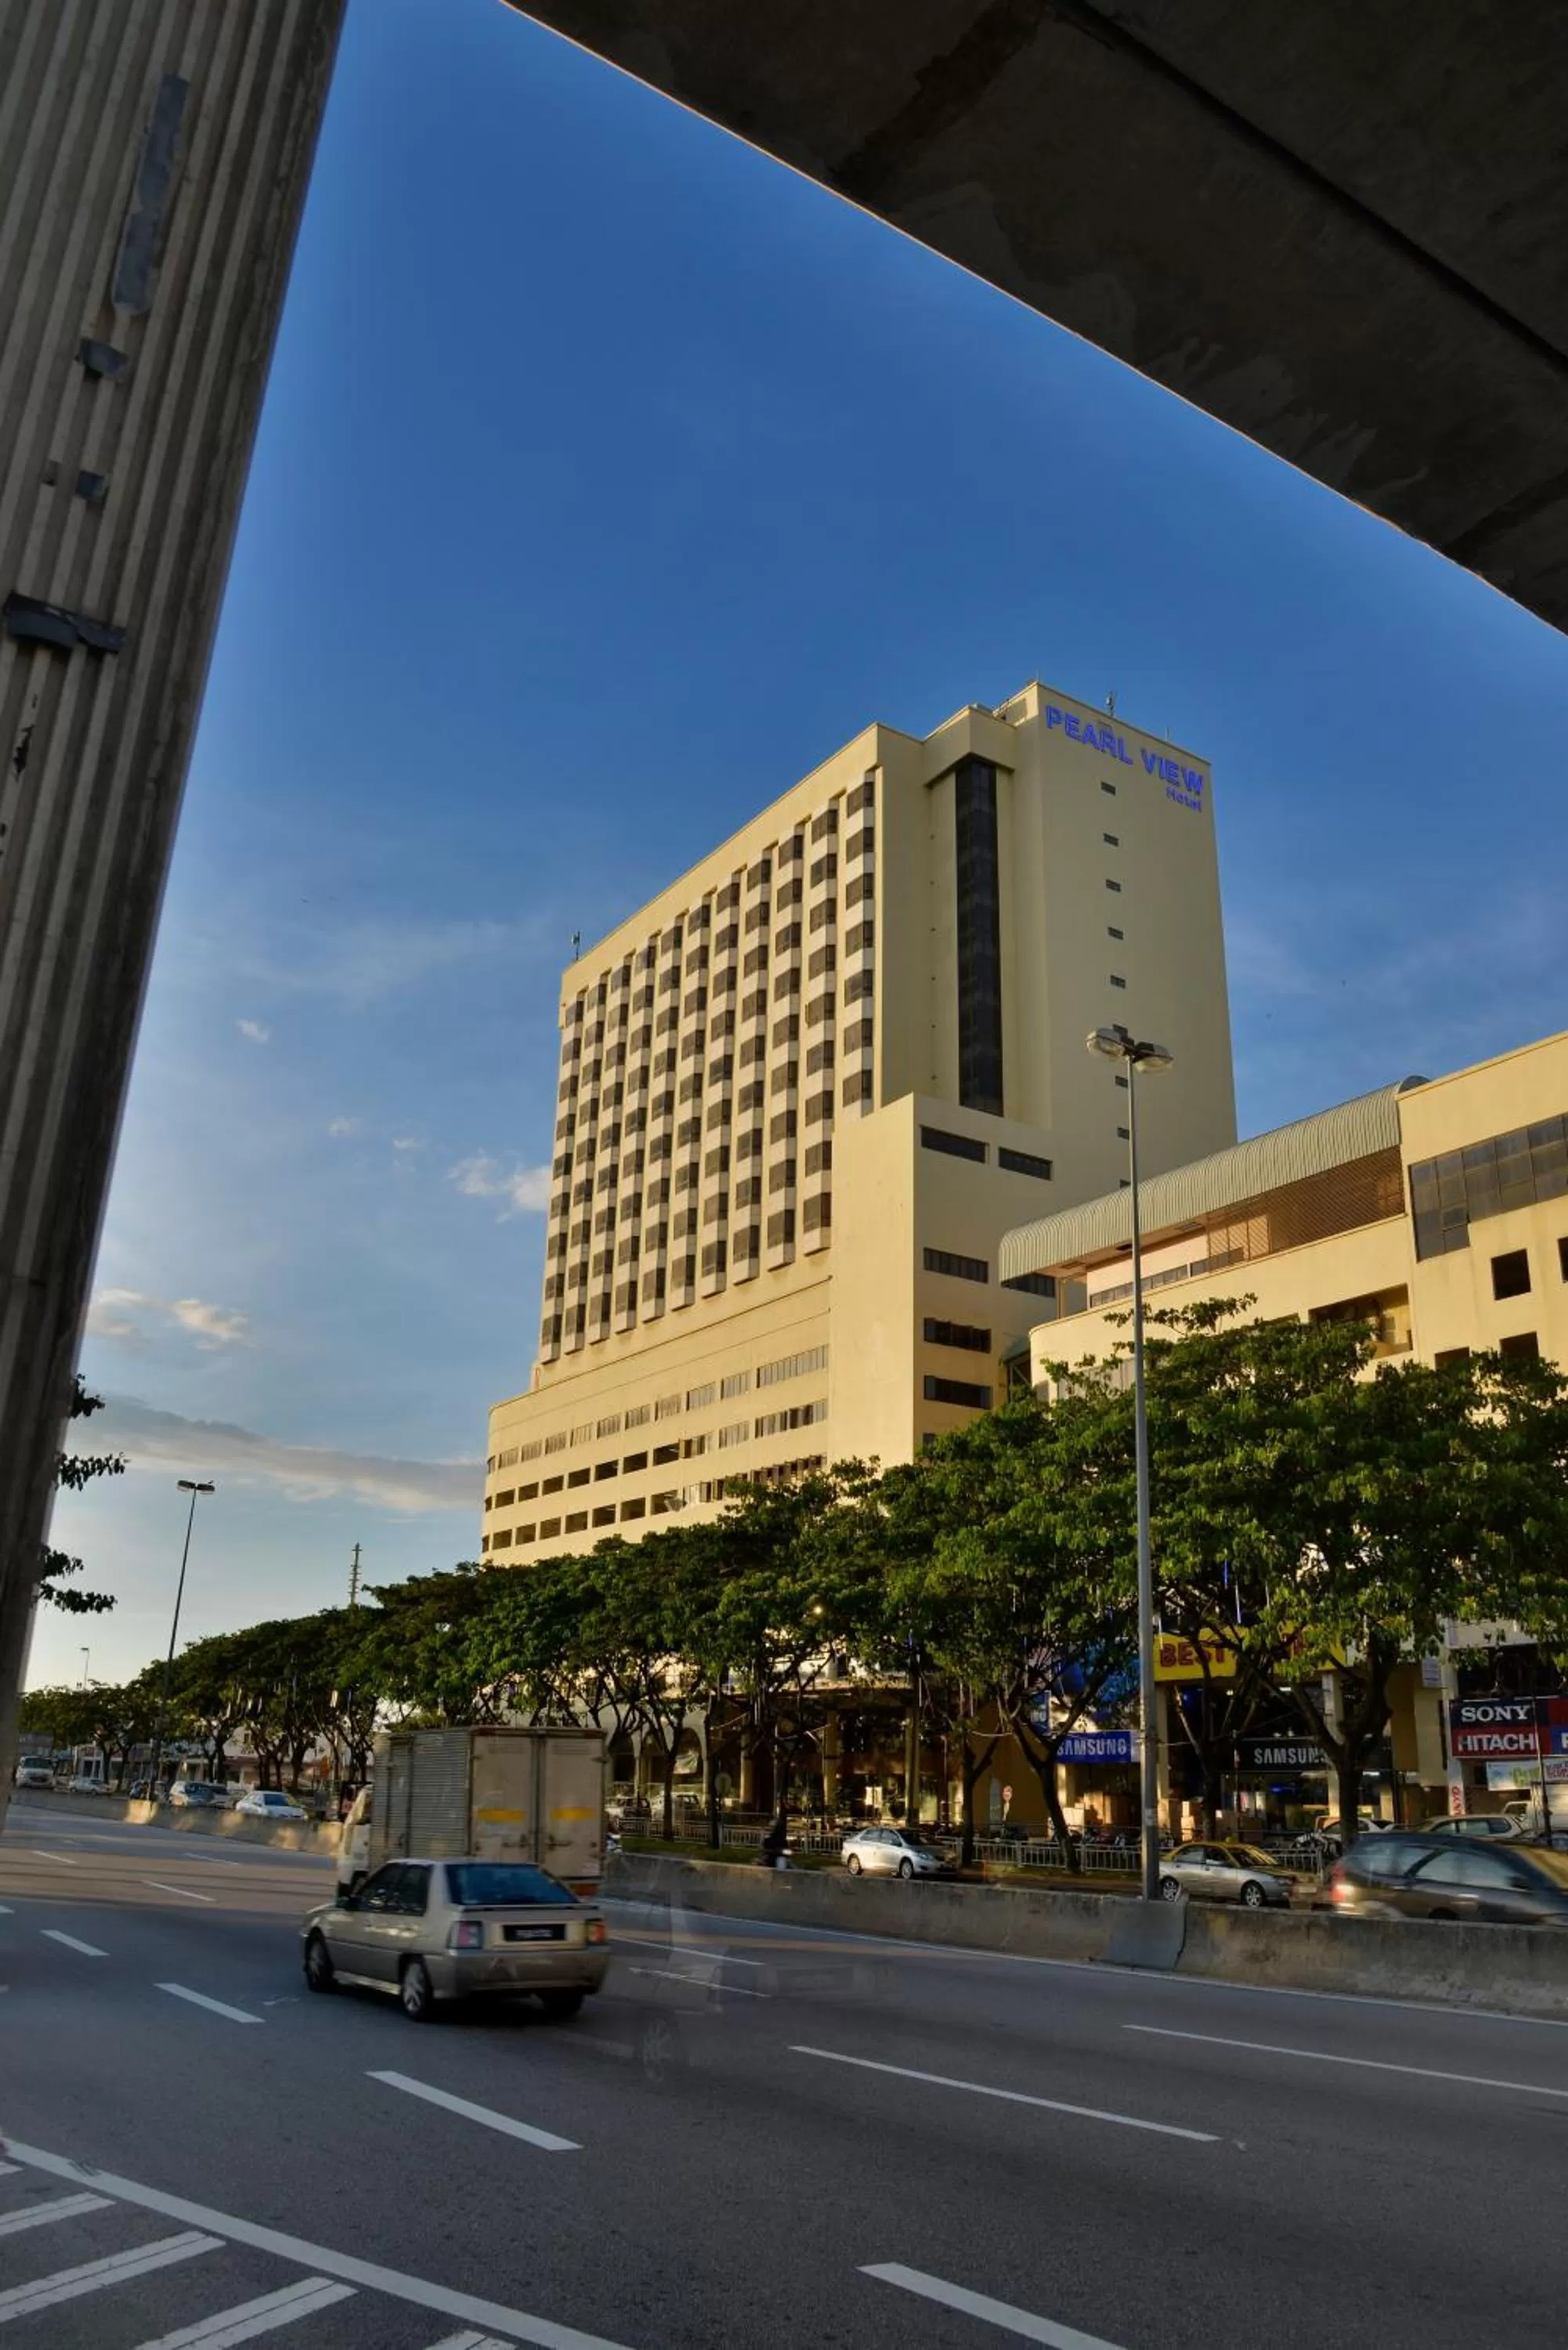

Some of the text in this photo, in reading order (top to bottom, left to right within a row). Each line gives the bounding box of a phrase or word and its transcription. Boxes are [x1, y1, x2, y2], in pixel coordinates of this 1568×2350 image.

[1046, 705, 1204, 795] PEARL VIEW
[1461, 1705, 1530, 1723] SONY
[1458, 1733, 1538, 1752] HITACH
